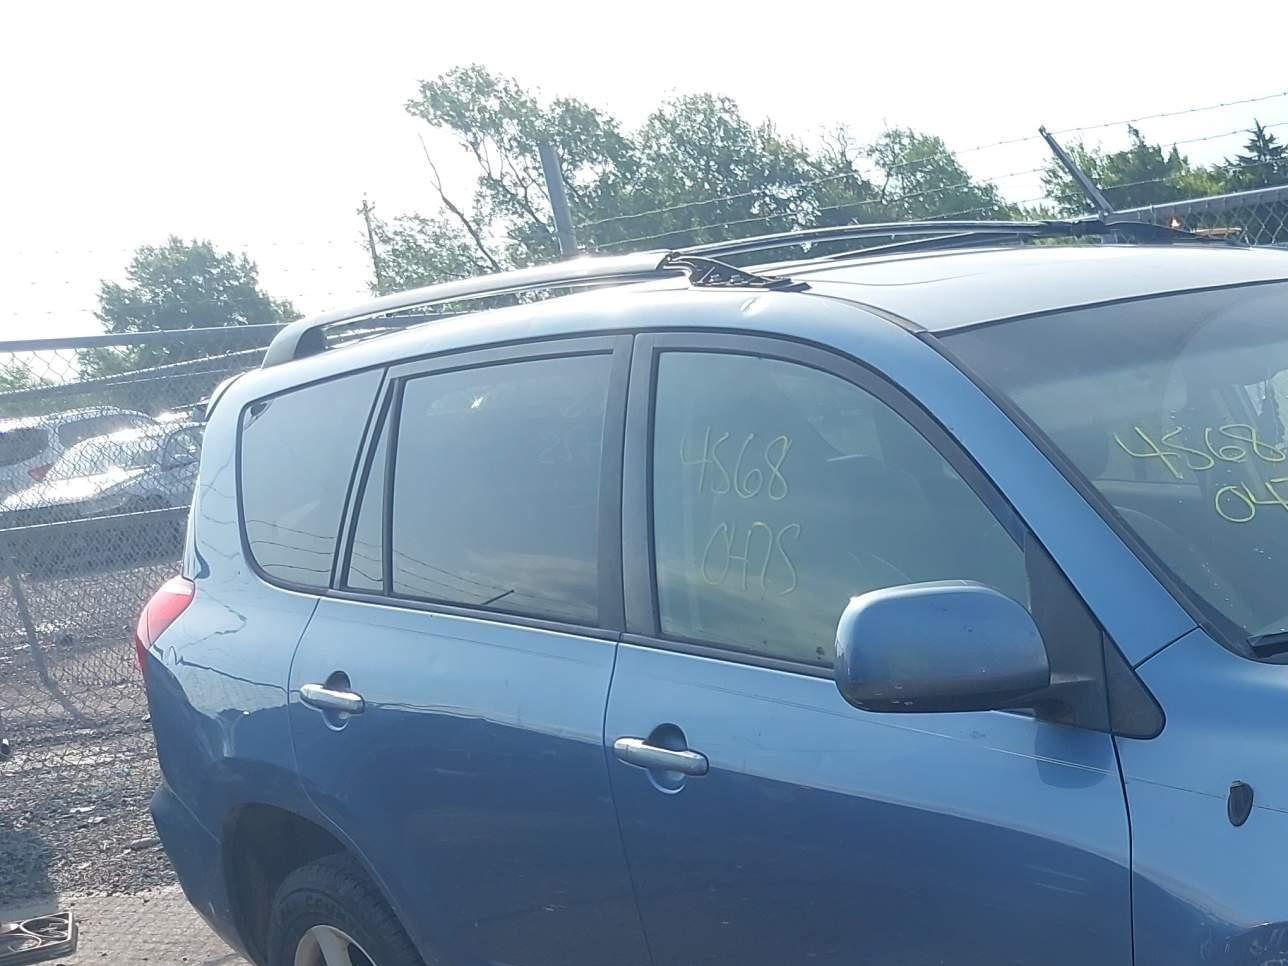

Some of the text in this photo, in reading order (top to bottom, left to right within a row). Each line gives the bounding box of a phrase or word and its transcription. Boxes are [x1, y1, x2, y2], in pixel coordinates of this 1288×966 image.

[680, 426, 793, 501] 4568
[1113, 423, 1288, 480] 4568
[702, 520, 801, 598] 0475
